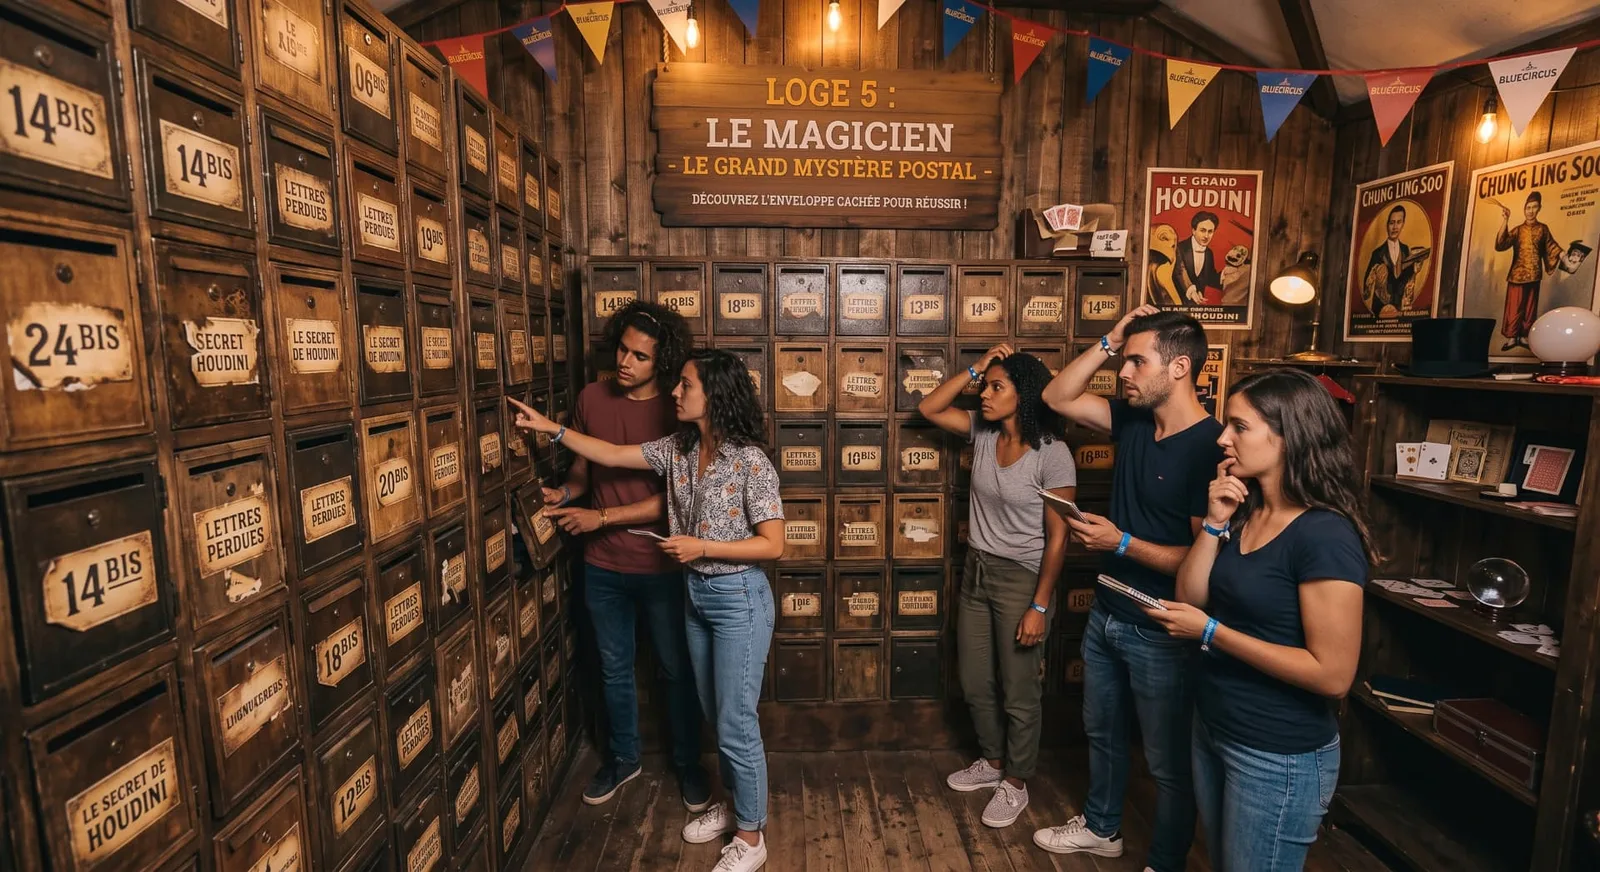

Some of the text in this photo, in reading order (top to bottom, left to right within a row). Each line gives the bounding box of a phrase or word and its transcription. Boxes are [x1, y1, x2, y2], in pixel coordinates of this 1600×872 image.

[1169, 73, 1206, 86] BLUECIRCUS
[1499, 68, 1557, 84] BLUECIRCUS
[766, 77, 849, 107] LOGE
[860, 79, 878, 108] 5
[1261, 85, 1303, 95] BLUECIRCUS
[1371, 85, 1421, 95] BLUECIRCUS
[8, 84, 96, 146] 14BIS
[706, 117, 953, 152] LE MAGICIEN
[177, 144, 233, 188] 14BIS
[682, 156, 708, 175] LE
[714, 155, 788, 177] GRAND
[793, 154, 893, 179] MYSTÈRE
[898, 161, 977, 180] POSTAL
[285, 179, 326, 204] LETTRES
[1172, 176, 1237, 187] LE GRAND
[1362, 173, 1443, 208] CHUNG LING SOO
[1478, 170, 1527, 199] CHUNG
[285, 197, 328, 222] PERDUES
[691, 190, 759, 206] DÉCOUVREZ
[761, 193, 835, 208] L'ENVELOPPE
[837, 193, 880, 208] CACHÉE
[883, 197, 913, 209] POUR
[916, 195, 962, 209] RÉUSSIR
[1155, 187, 1251, 217] HOUDINI
[363, 205, 394, 226] LETTRES
[364, 221, 396, 241] PERDUES
[847, 306, 879, 315] PERDUES
[1027, 301, 1058, 309] LETTRES
[25, 322, 120, 367] 24BIS
[195, 333, 244, 350] SECRET
[293, 330, 335, 345] LE SECRET
[369, 336, 401, 349] LE SECRET
[196, 353, 250, 373] HOUDINI
[293, 347, 339, 361] DE HOUDINI
[369, 351, 378, 363] DE
[846, 383, 878, 393] PERDUES
[847, 376, 877, 385] LETTRES
[1086, 382, 1112, 390] ERDUES
[786, 451, 817, 459] LETTRES
[786, 459, 817, 467] PERDUES
[311, 489, 345, 512] LETTRES
[205, 506, 262, 541] LETTRES
[311, 504, 346, 528] PERDUES
[207, 527, 265, 563] PERDUES
[390, 592, 418, 620] LETTRES
[391, 605, 419, 635] PERDUES
[82, 758, 167, 825] LE SECRET DE
[87, 779, 169, 854] HOUDINI
